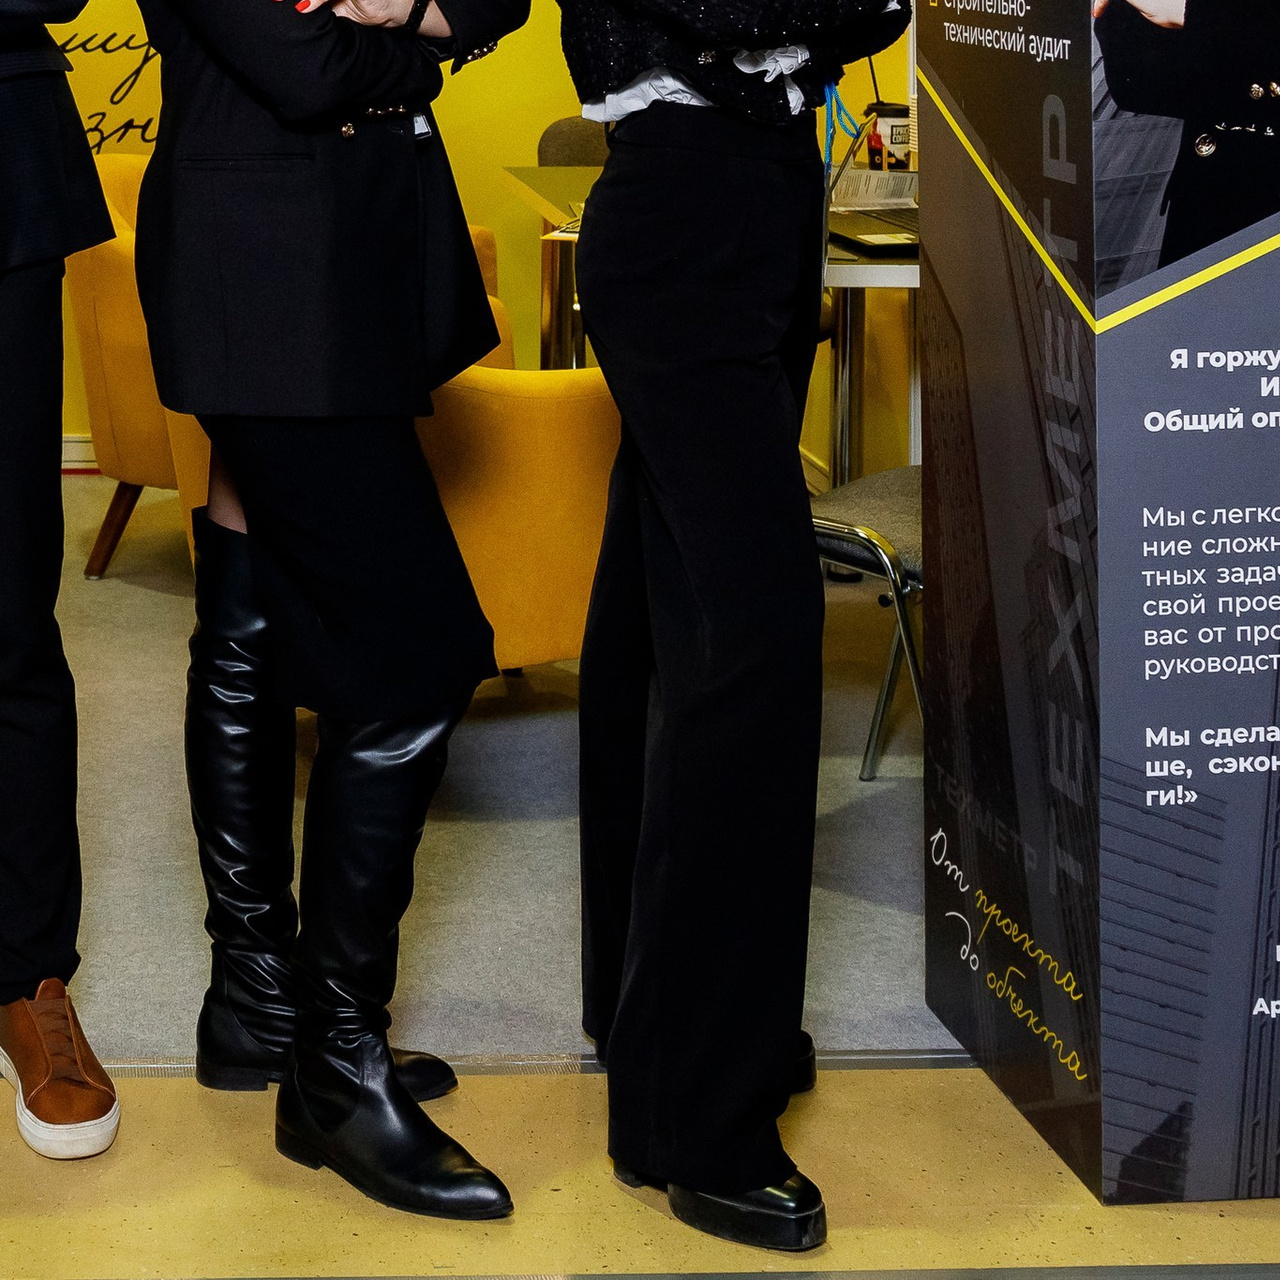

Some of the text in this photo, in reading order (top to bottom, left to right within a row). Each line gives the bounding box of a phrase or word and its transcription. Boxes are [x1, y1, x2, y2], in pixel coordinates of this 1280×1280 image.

[943, 21, 1072, 63] технический аудит
[1170, 348, 1188, 369] Я
[1143, 407, 1244, 433] Общий
[1143, 506, 1186, 527] Мы
[1192, 509, 1207, 525] с
[1143, 540, 1192, 557] ние
[1141, 566, 1280, 587] тных зада
[1143, 593, 1206, 616] свой
[1144, 628, 1188, 646] вас
[1198, 626, 1227, 643] от
[1145, 726, 1190, 747] Мы
[1146, 759, 1193, 779] ше,
[1146, 784, 1198, 807] ги!»
[930, 827, 1083, 1001] От проекта
[945, 911, 1088, 1081] до объекта
